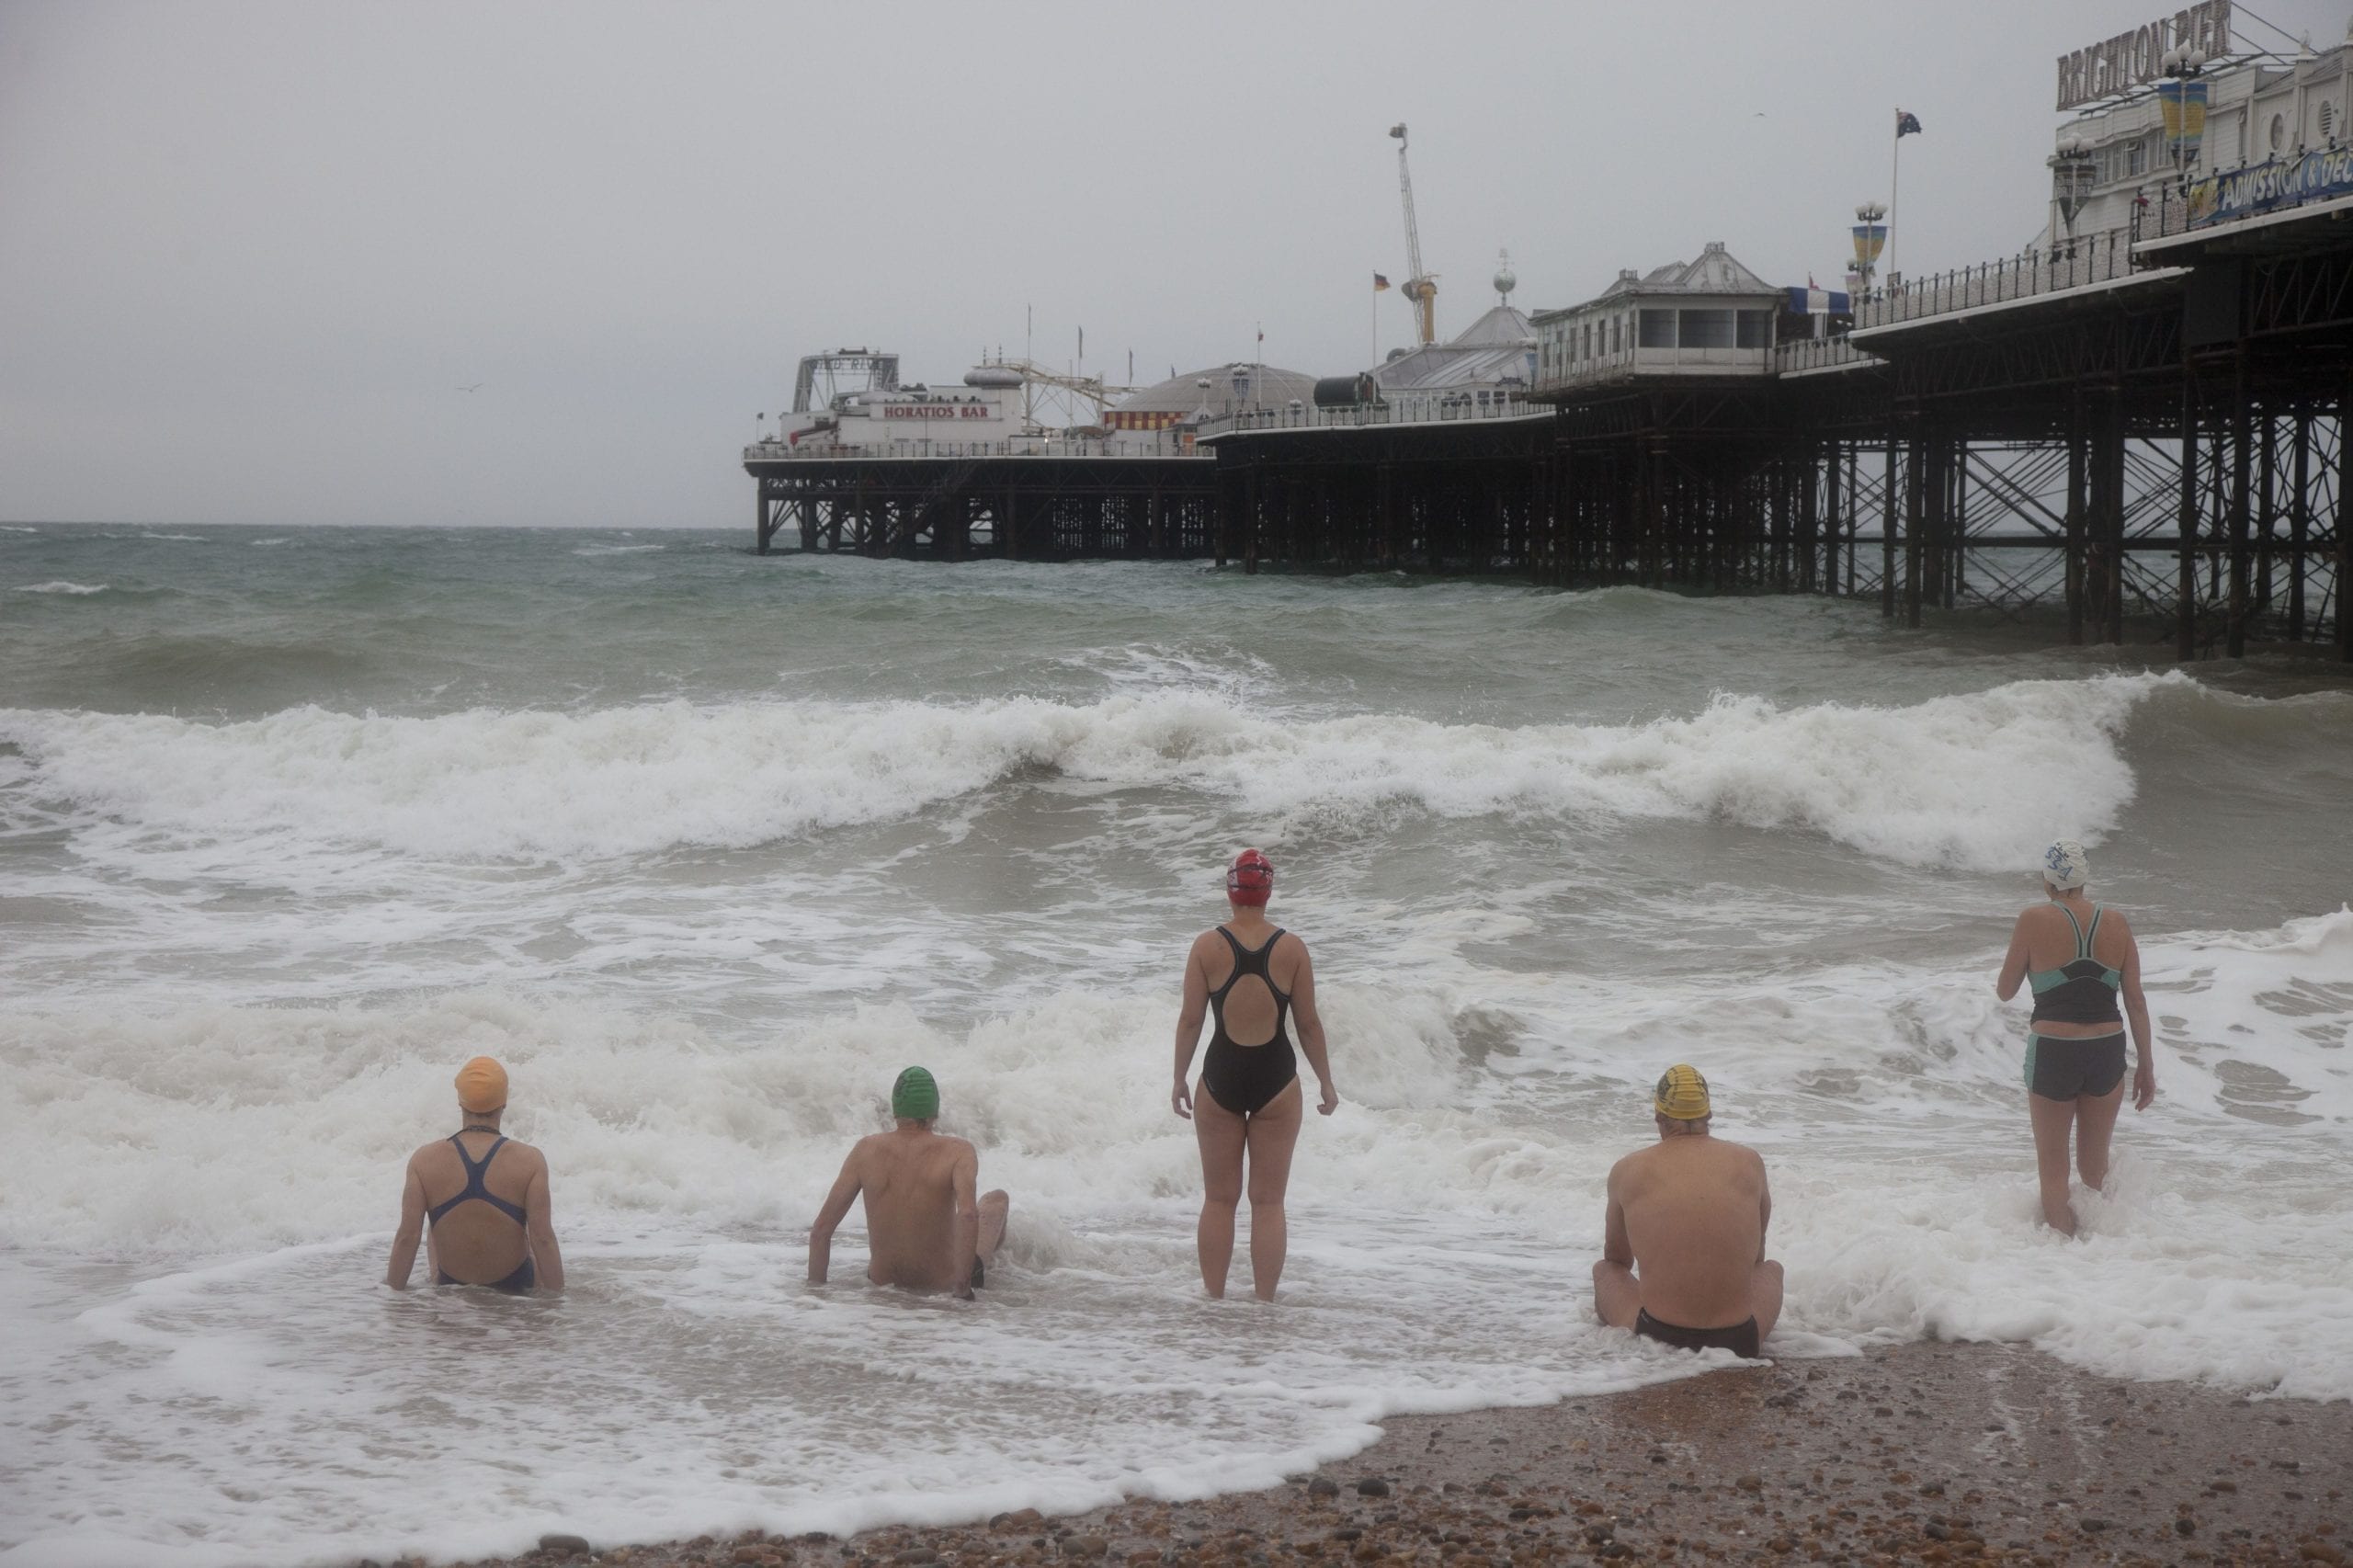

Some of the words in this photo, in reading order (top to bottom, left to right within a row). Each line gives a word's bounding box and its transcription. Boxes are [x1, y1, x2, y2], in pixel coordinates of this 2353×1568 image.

[2056, 17, 2170, 111] BRIGHTON
[2175, 0, 2234, 63] PIER
[2222, 161, 2303, 210] ADMISSION
[2321, 149, 2353, 187] DEC
[884, 406, 954, 418] HORATIOS
[961, 406, 988, 418] BAR
